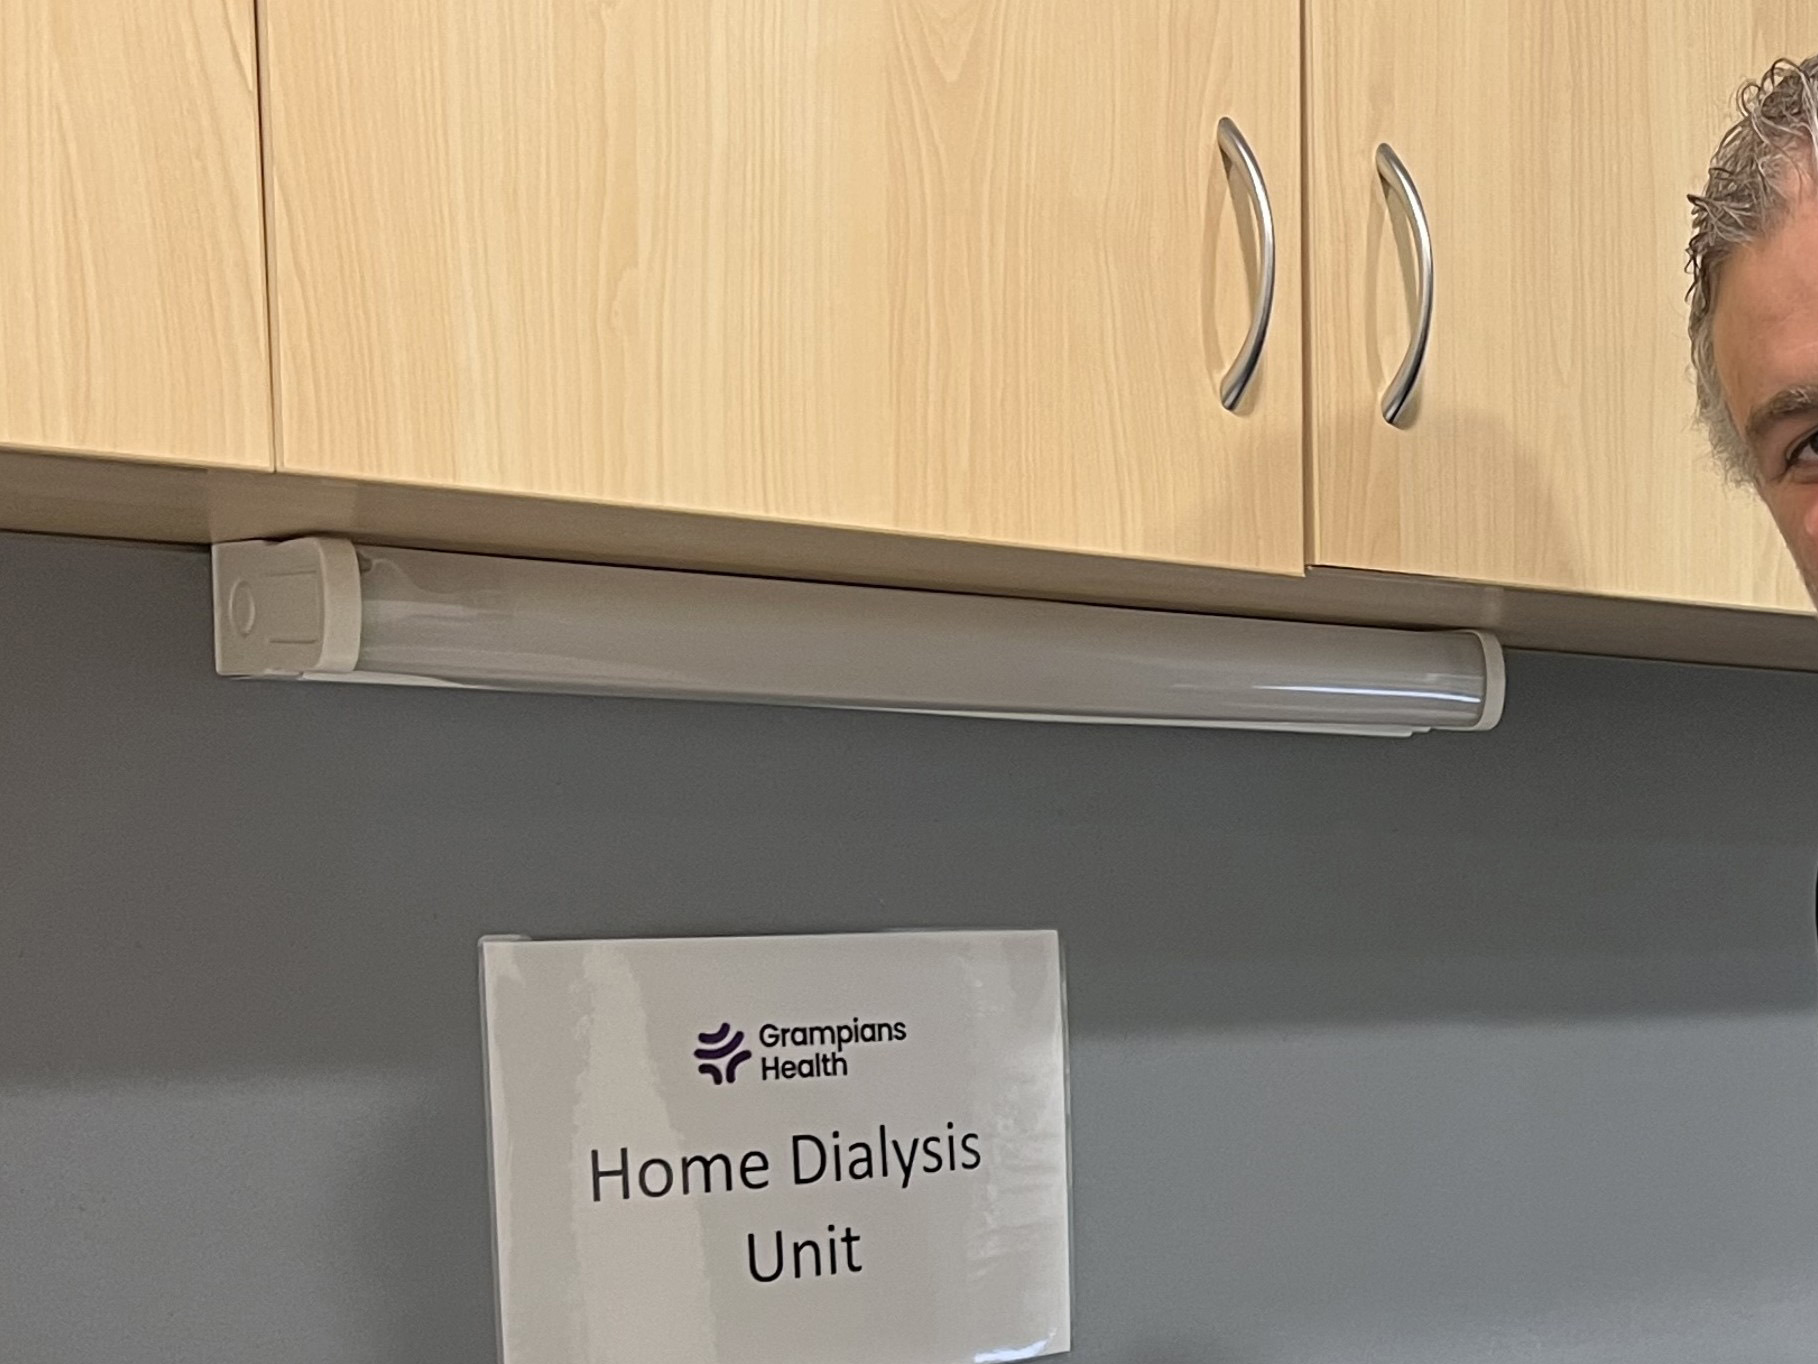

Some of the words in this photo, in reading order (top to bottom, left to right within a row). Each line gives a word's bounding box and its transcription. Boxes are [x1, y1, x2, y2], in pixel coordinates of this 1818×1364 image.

[759, 1016, 907, 1053] Grampians
[761, 1052, 848, 1081] Health
[590, 1146, 771, 1202] Home
[792, 1121, 982, 1190] Dialysis
[747, 1223, 863, 1283] Unit
